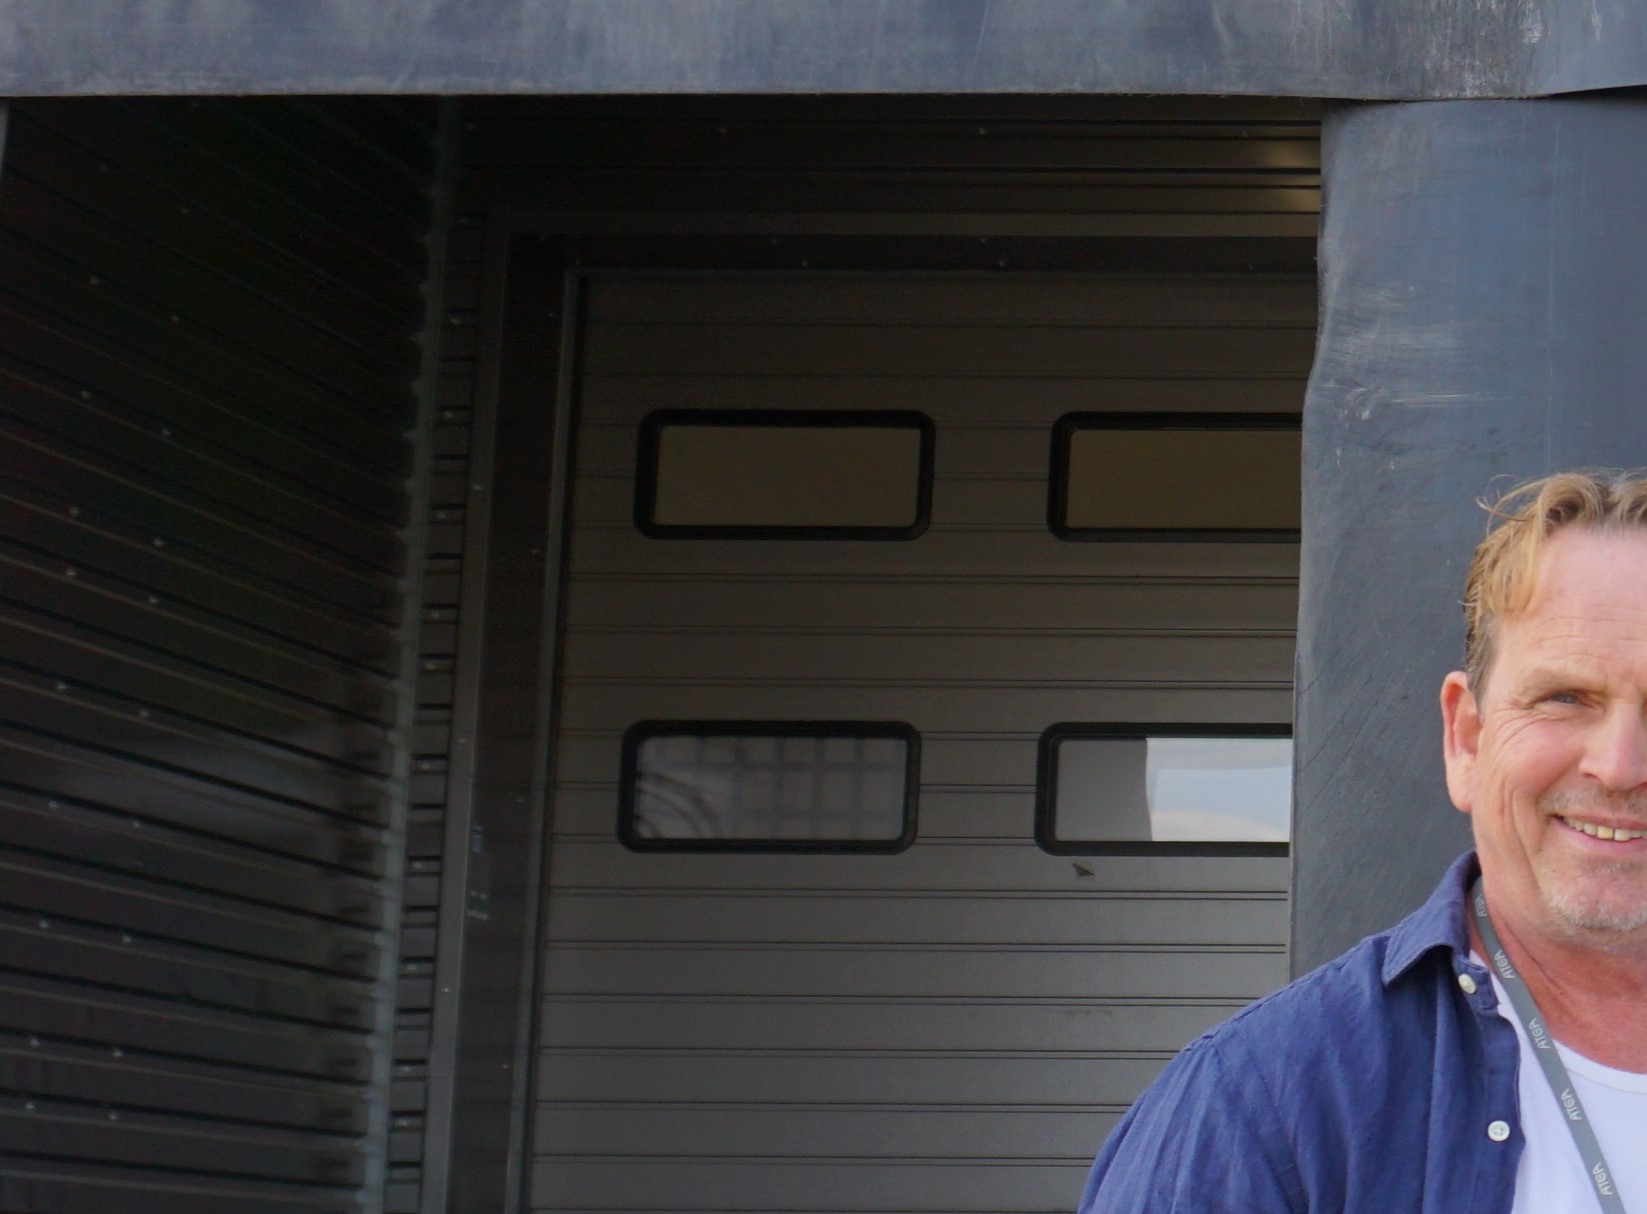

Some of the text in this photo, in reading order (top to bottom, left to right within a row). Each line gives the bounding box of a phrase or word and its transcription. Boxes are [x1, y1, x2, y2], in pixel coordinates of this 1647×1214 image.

[1494, 949, 1516, 979] ATEA
[1529, 1018, 1551, 1049] ATEA
[1560, 1087, 1582, 1121] ATEA
[1592, 1161, 1613, 1196] ATEA
